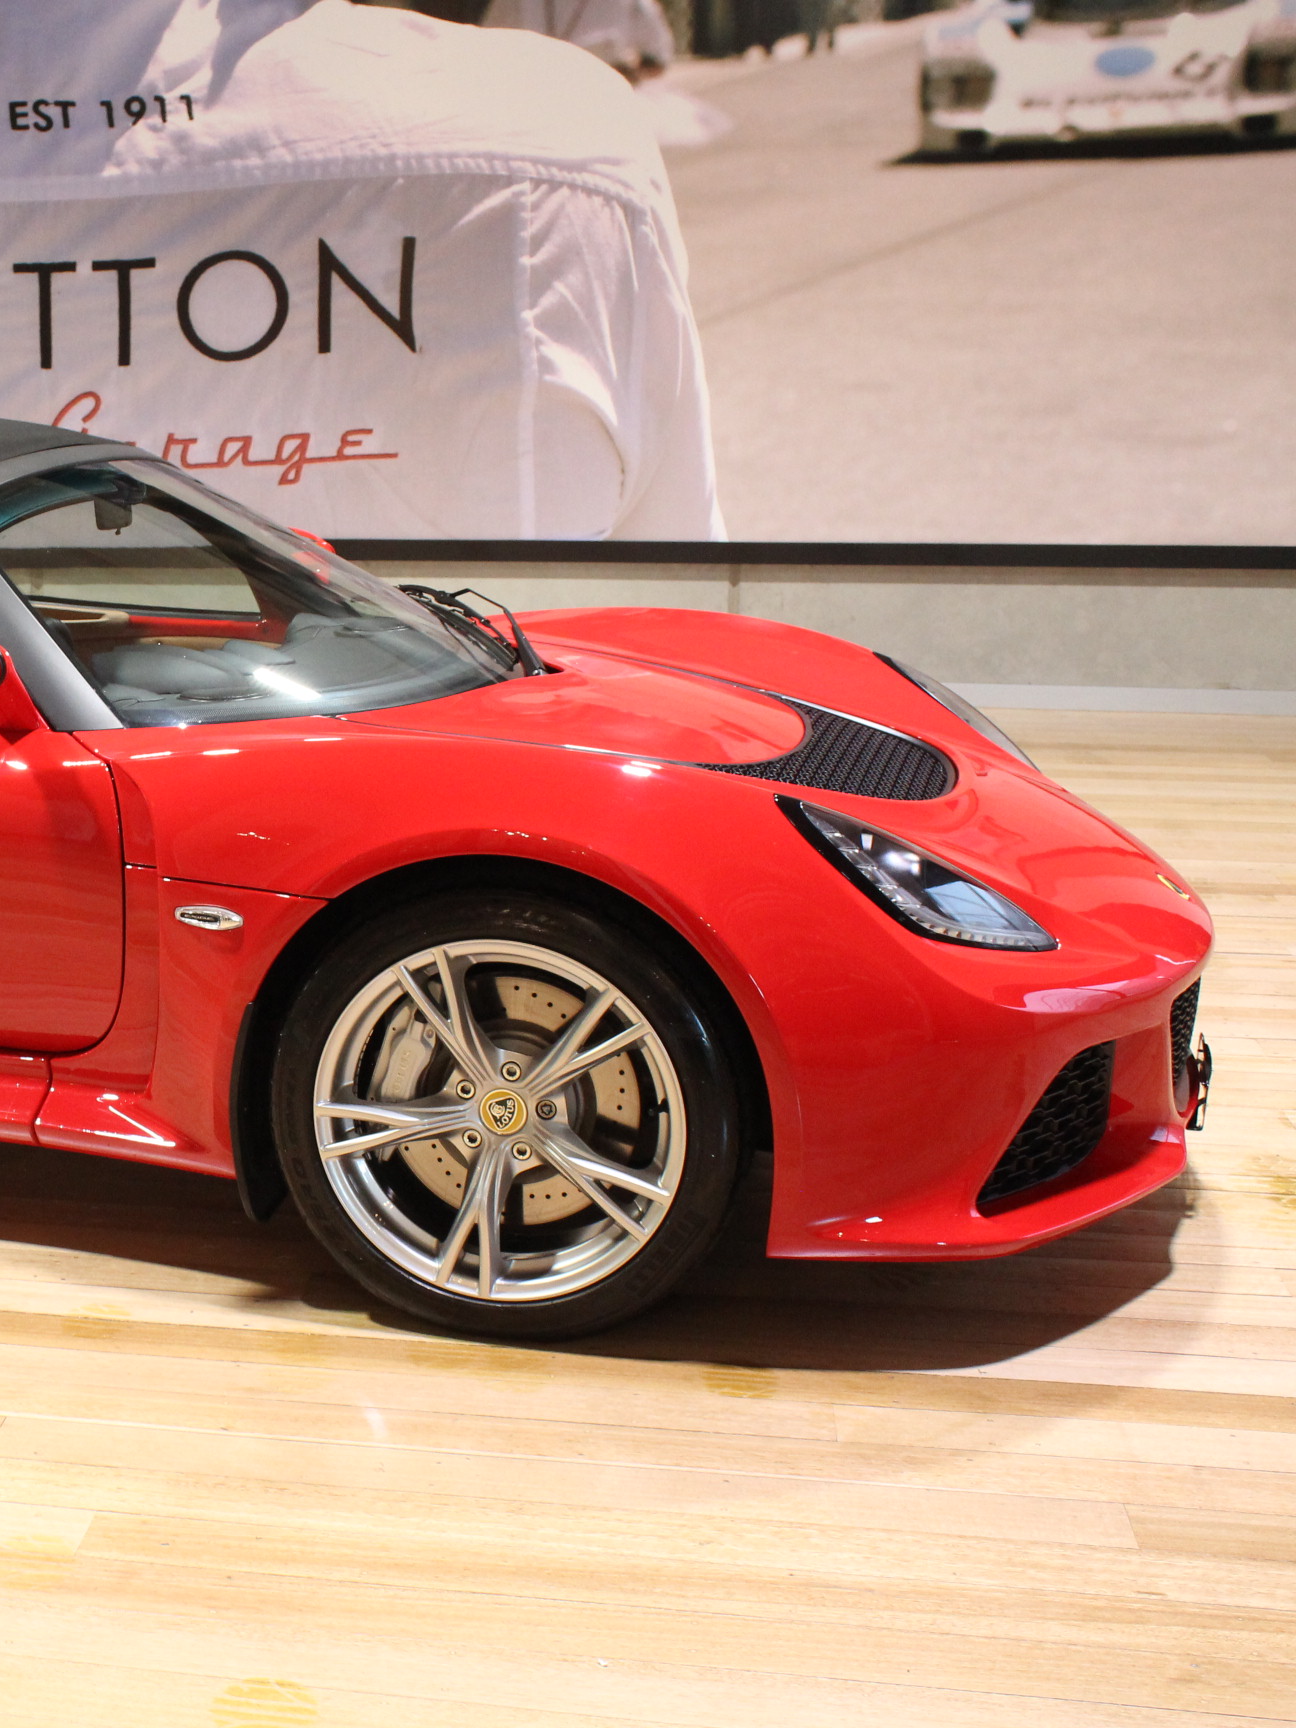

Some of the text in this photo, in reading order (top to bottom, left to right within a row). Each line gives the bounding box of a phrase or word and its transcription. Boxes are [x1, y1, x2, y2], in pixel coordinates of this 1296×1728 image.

[8, 94, 195, 132] EST 1911
[50, 390, 399, 487] Grage
[496, 1099, 515, 1129] LOTUS
